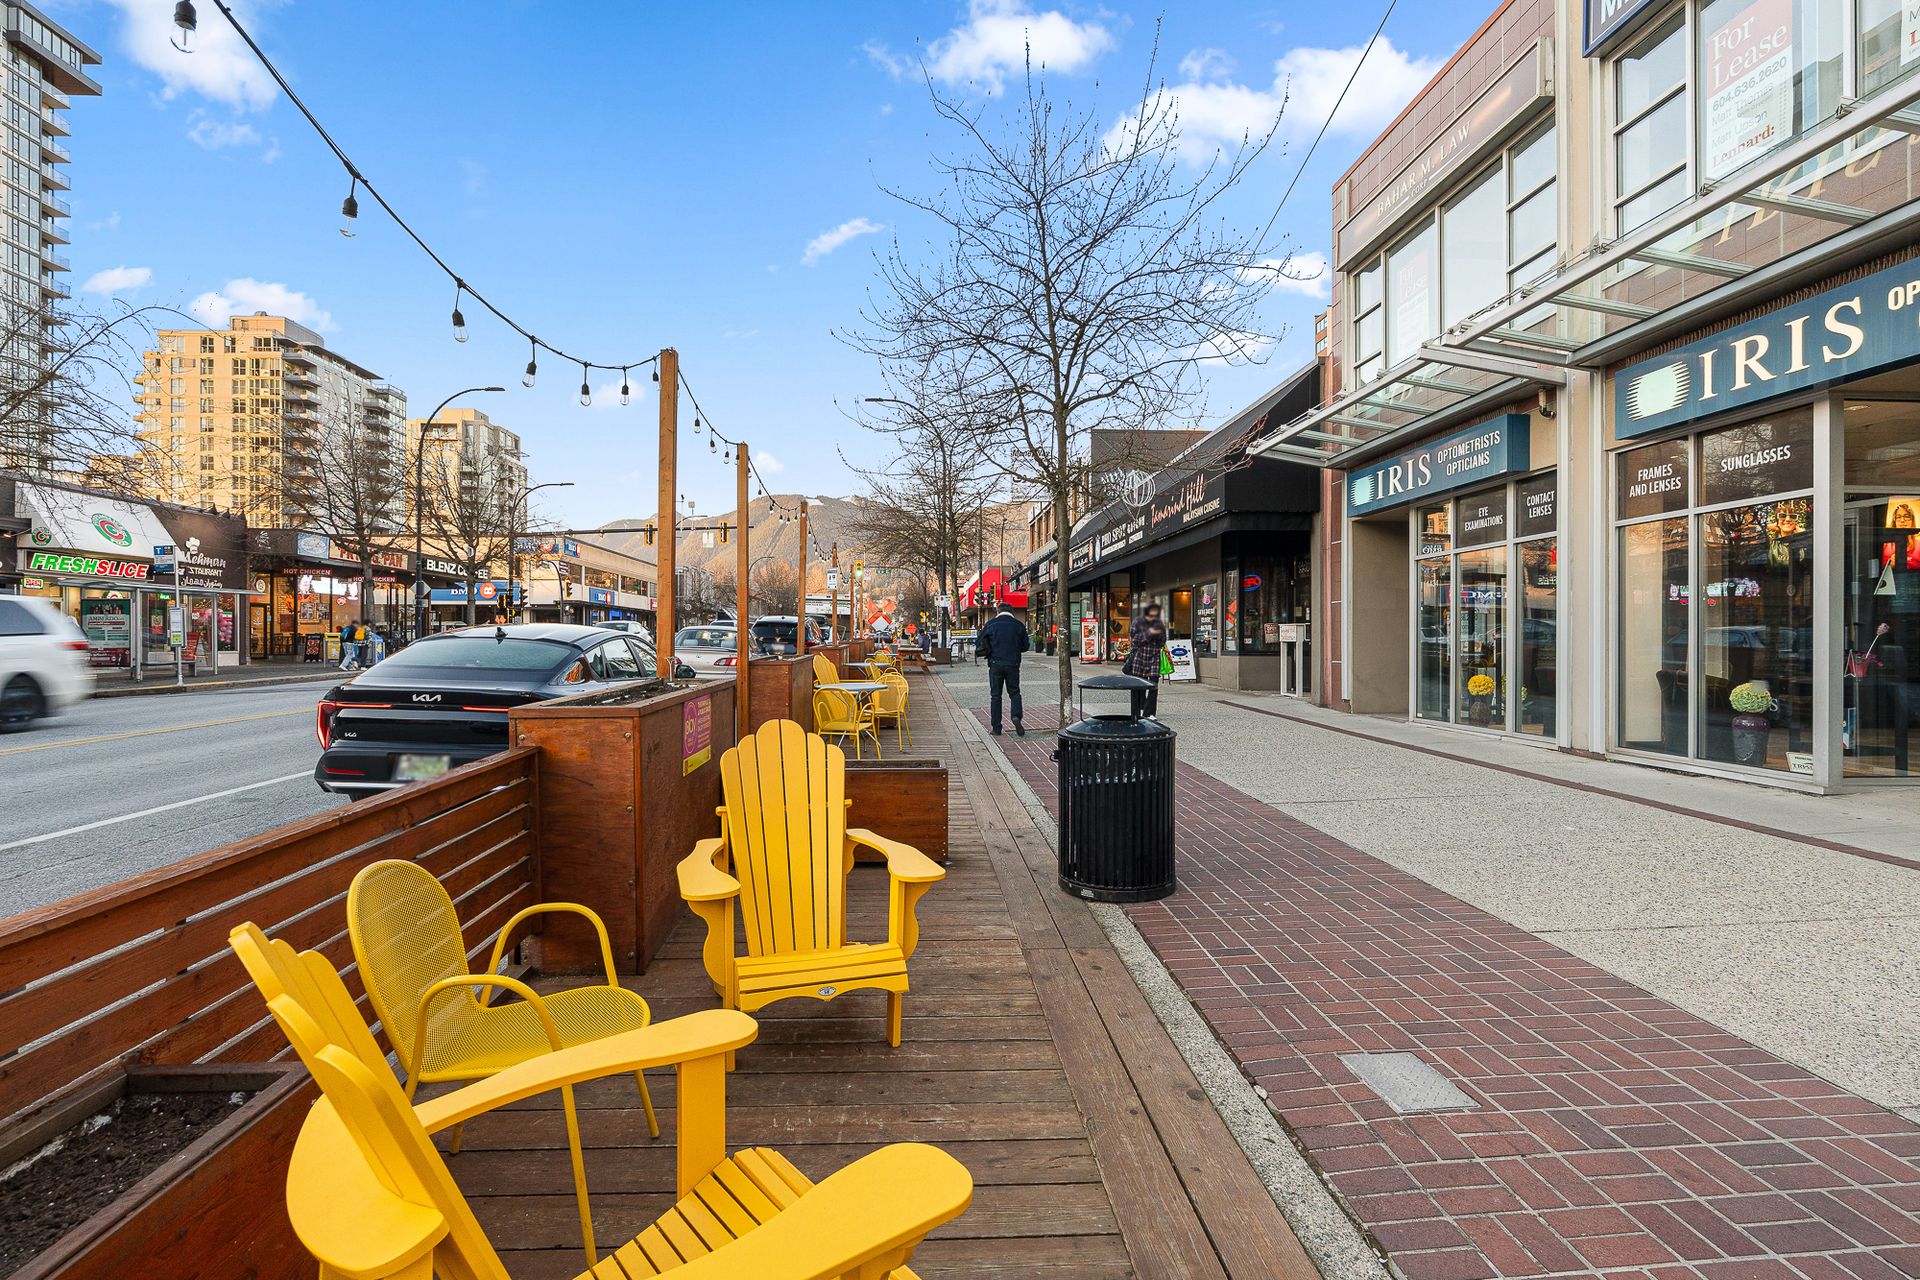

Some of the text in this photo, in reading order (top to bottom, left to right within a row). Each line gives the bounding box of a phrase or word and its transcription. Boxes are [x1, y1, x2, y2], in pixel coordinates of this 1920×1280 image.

[1712, 16, 1755, 63] For
[1713, 24, 1787, 91] Lease
[1712, 56, 1787, 112] 604.636.2620
[1377, 120, 1471, 217] BAHAR M. LAW
[1698, 296, 1864, 401] IRIS
[1437, 430, 1501, 464] OPTOMETRISTS
[1720, 445, 1791, 472] SUNGLASSES
[1446, 451, 1490, 476] OPTICIANS
[1638, 463, 1673, 482] FRAMES
[1376, 453, 1432, 500] IRIS
[1629, 477, 1682, 498] AND LENSES
[1186, 473, 1206, 512] Hill
[1526, 490, 1555, 507] CONTACT
[1464, 514, 1504, 531] EXAMINATIONS
[1478, 506, 1489, 517] EYE
[1528, 504, 1552, 518] LENSES
[30, 552, 149, 579] FRESHSLICE
[300, 568, 331, 576] CHICKEN
[426, 559, 457, 574] BLENZ
[25, 579, 41, 587] OPEN
[412, 693, 442, 702] KIA
